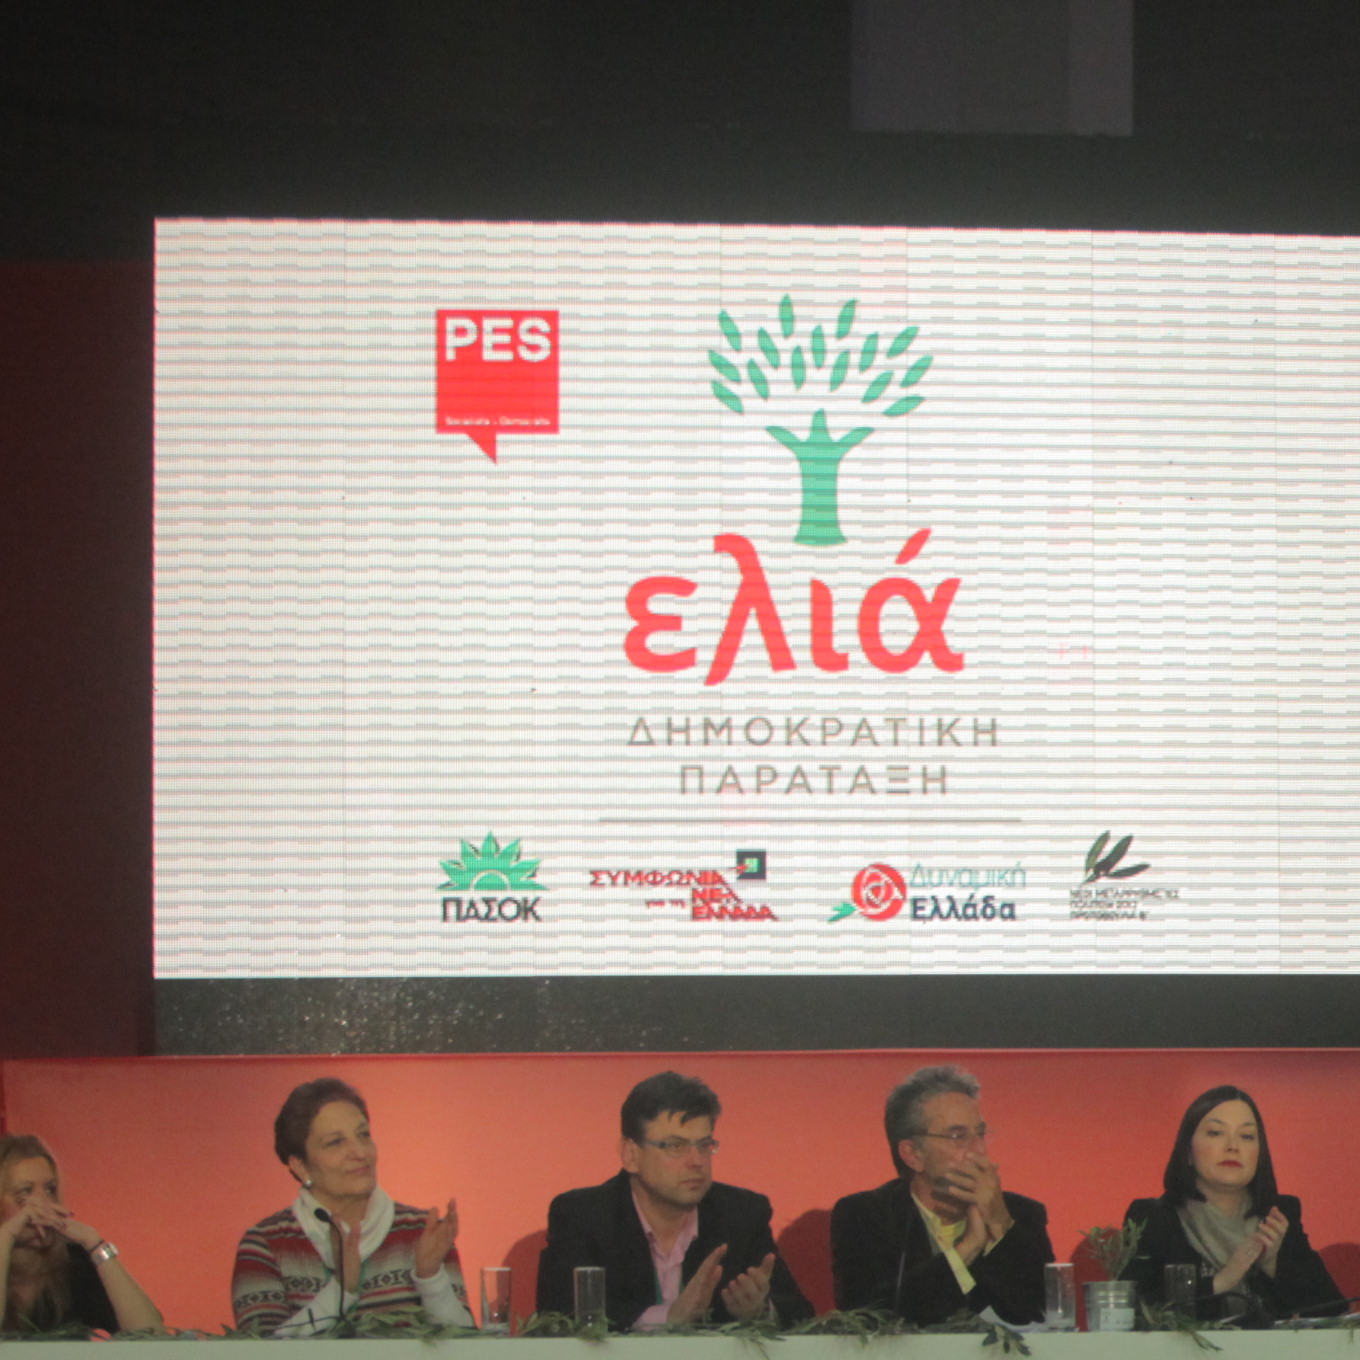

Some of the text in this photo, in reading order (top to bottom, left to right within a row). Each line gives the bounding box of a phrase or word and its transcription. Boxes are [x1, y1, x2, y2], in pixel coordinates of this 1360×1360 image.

[445, 316, 552, 363] PES
[623, 527, 965, 687] ελιά
[626, 715, 999, 747] ΔΗΜΟΚΡΑΤΙΚΗ
[679, 763, 948, 796] ΠΑΡΑΤΑΞΗ
[441, 896, 542, 923] ΠΑΣΟΚ
[911, 892, 1017, 922] Ελλάδα
